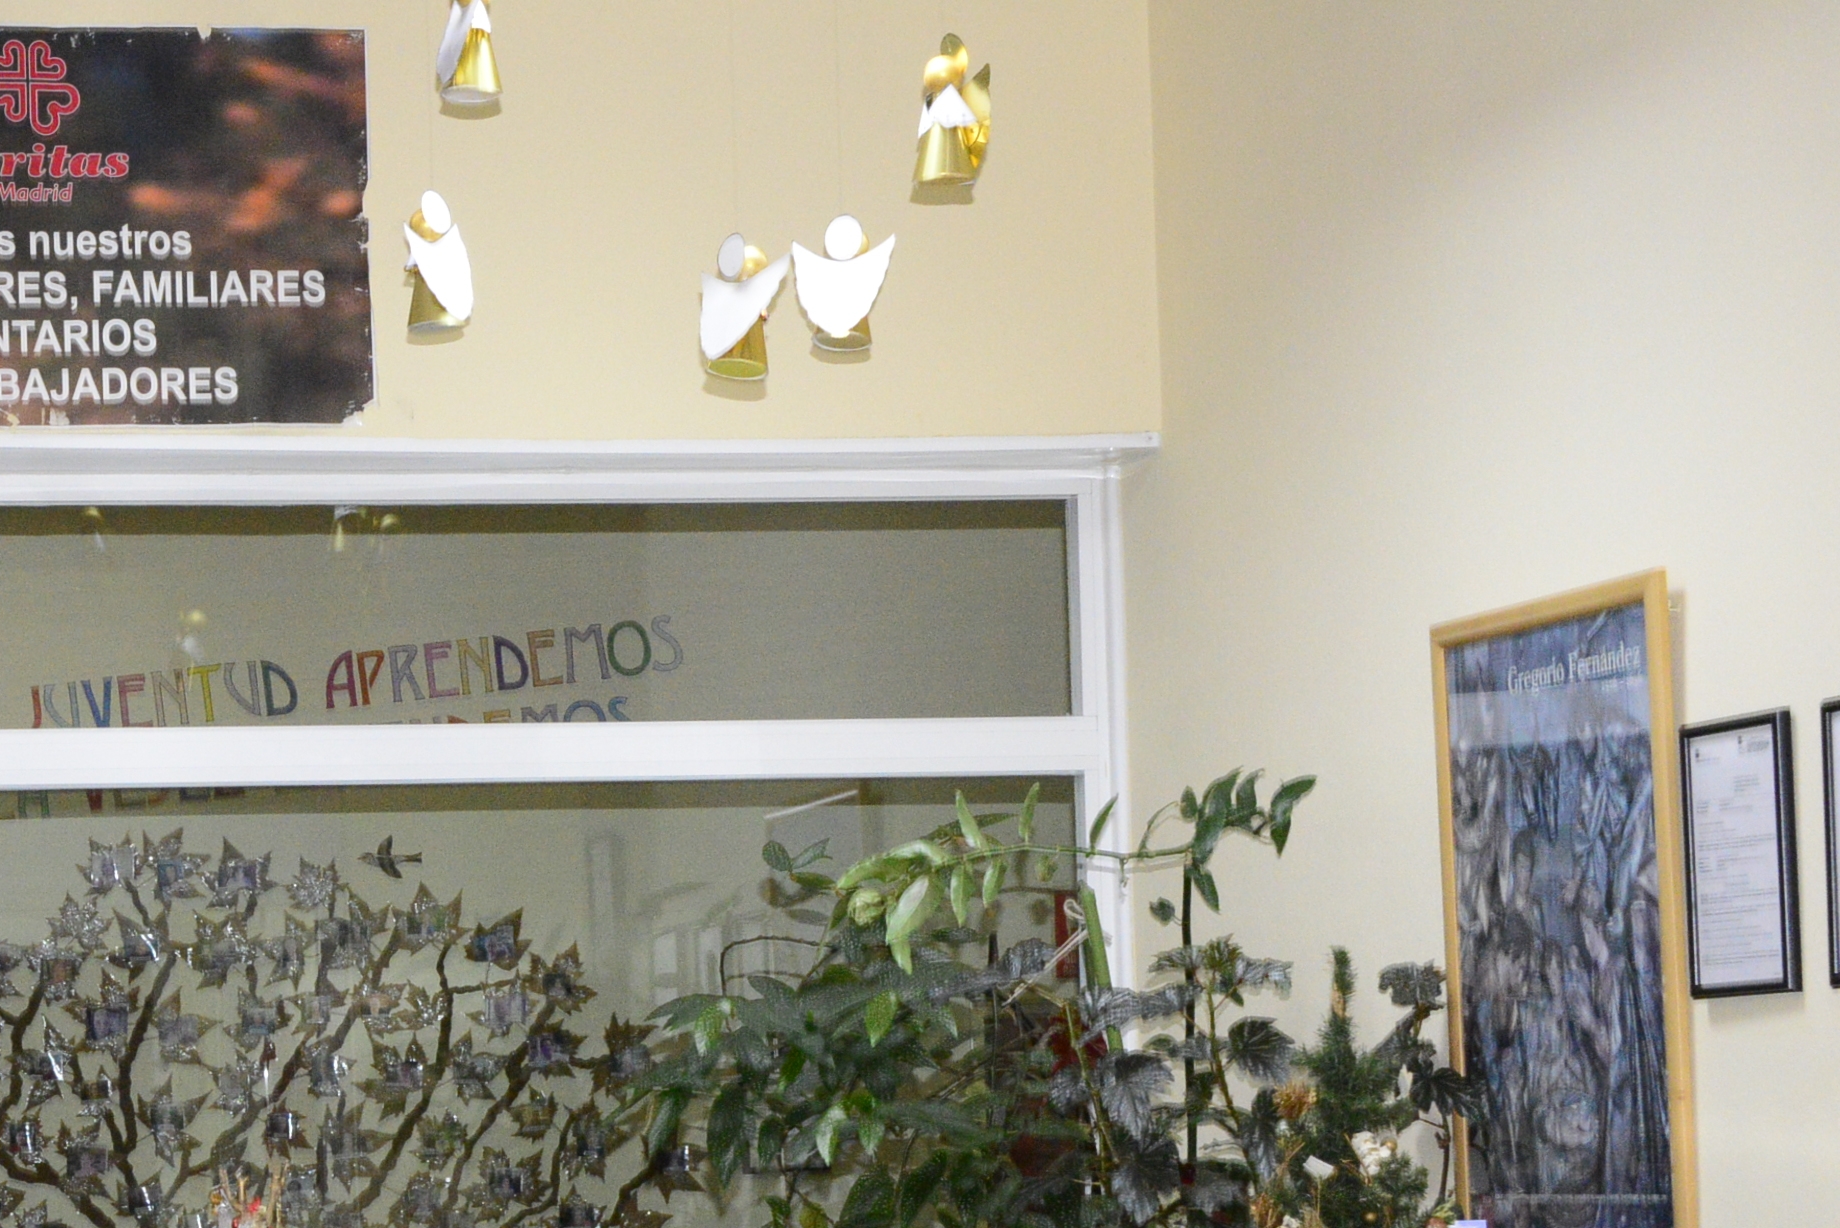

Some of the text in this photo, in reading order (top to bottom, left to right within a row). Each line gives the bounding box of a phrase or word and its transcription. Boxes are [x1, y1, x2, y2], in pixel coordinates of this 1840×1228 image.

[29, 226, 193, 258] nuestros
[92, 269, 325, 306] FAMILIARES
[325, 614, 684, 710] APRENDEMOS
[1507, 656, 1565, 697] Gregorio
[1568, 640, 1641, 681] Fernández
